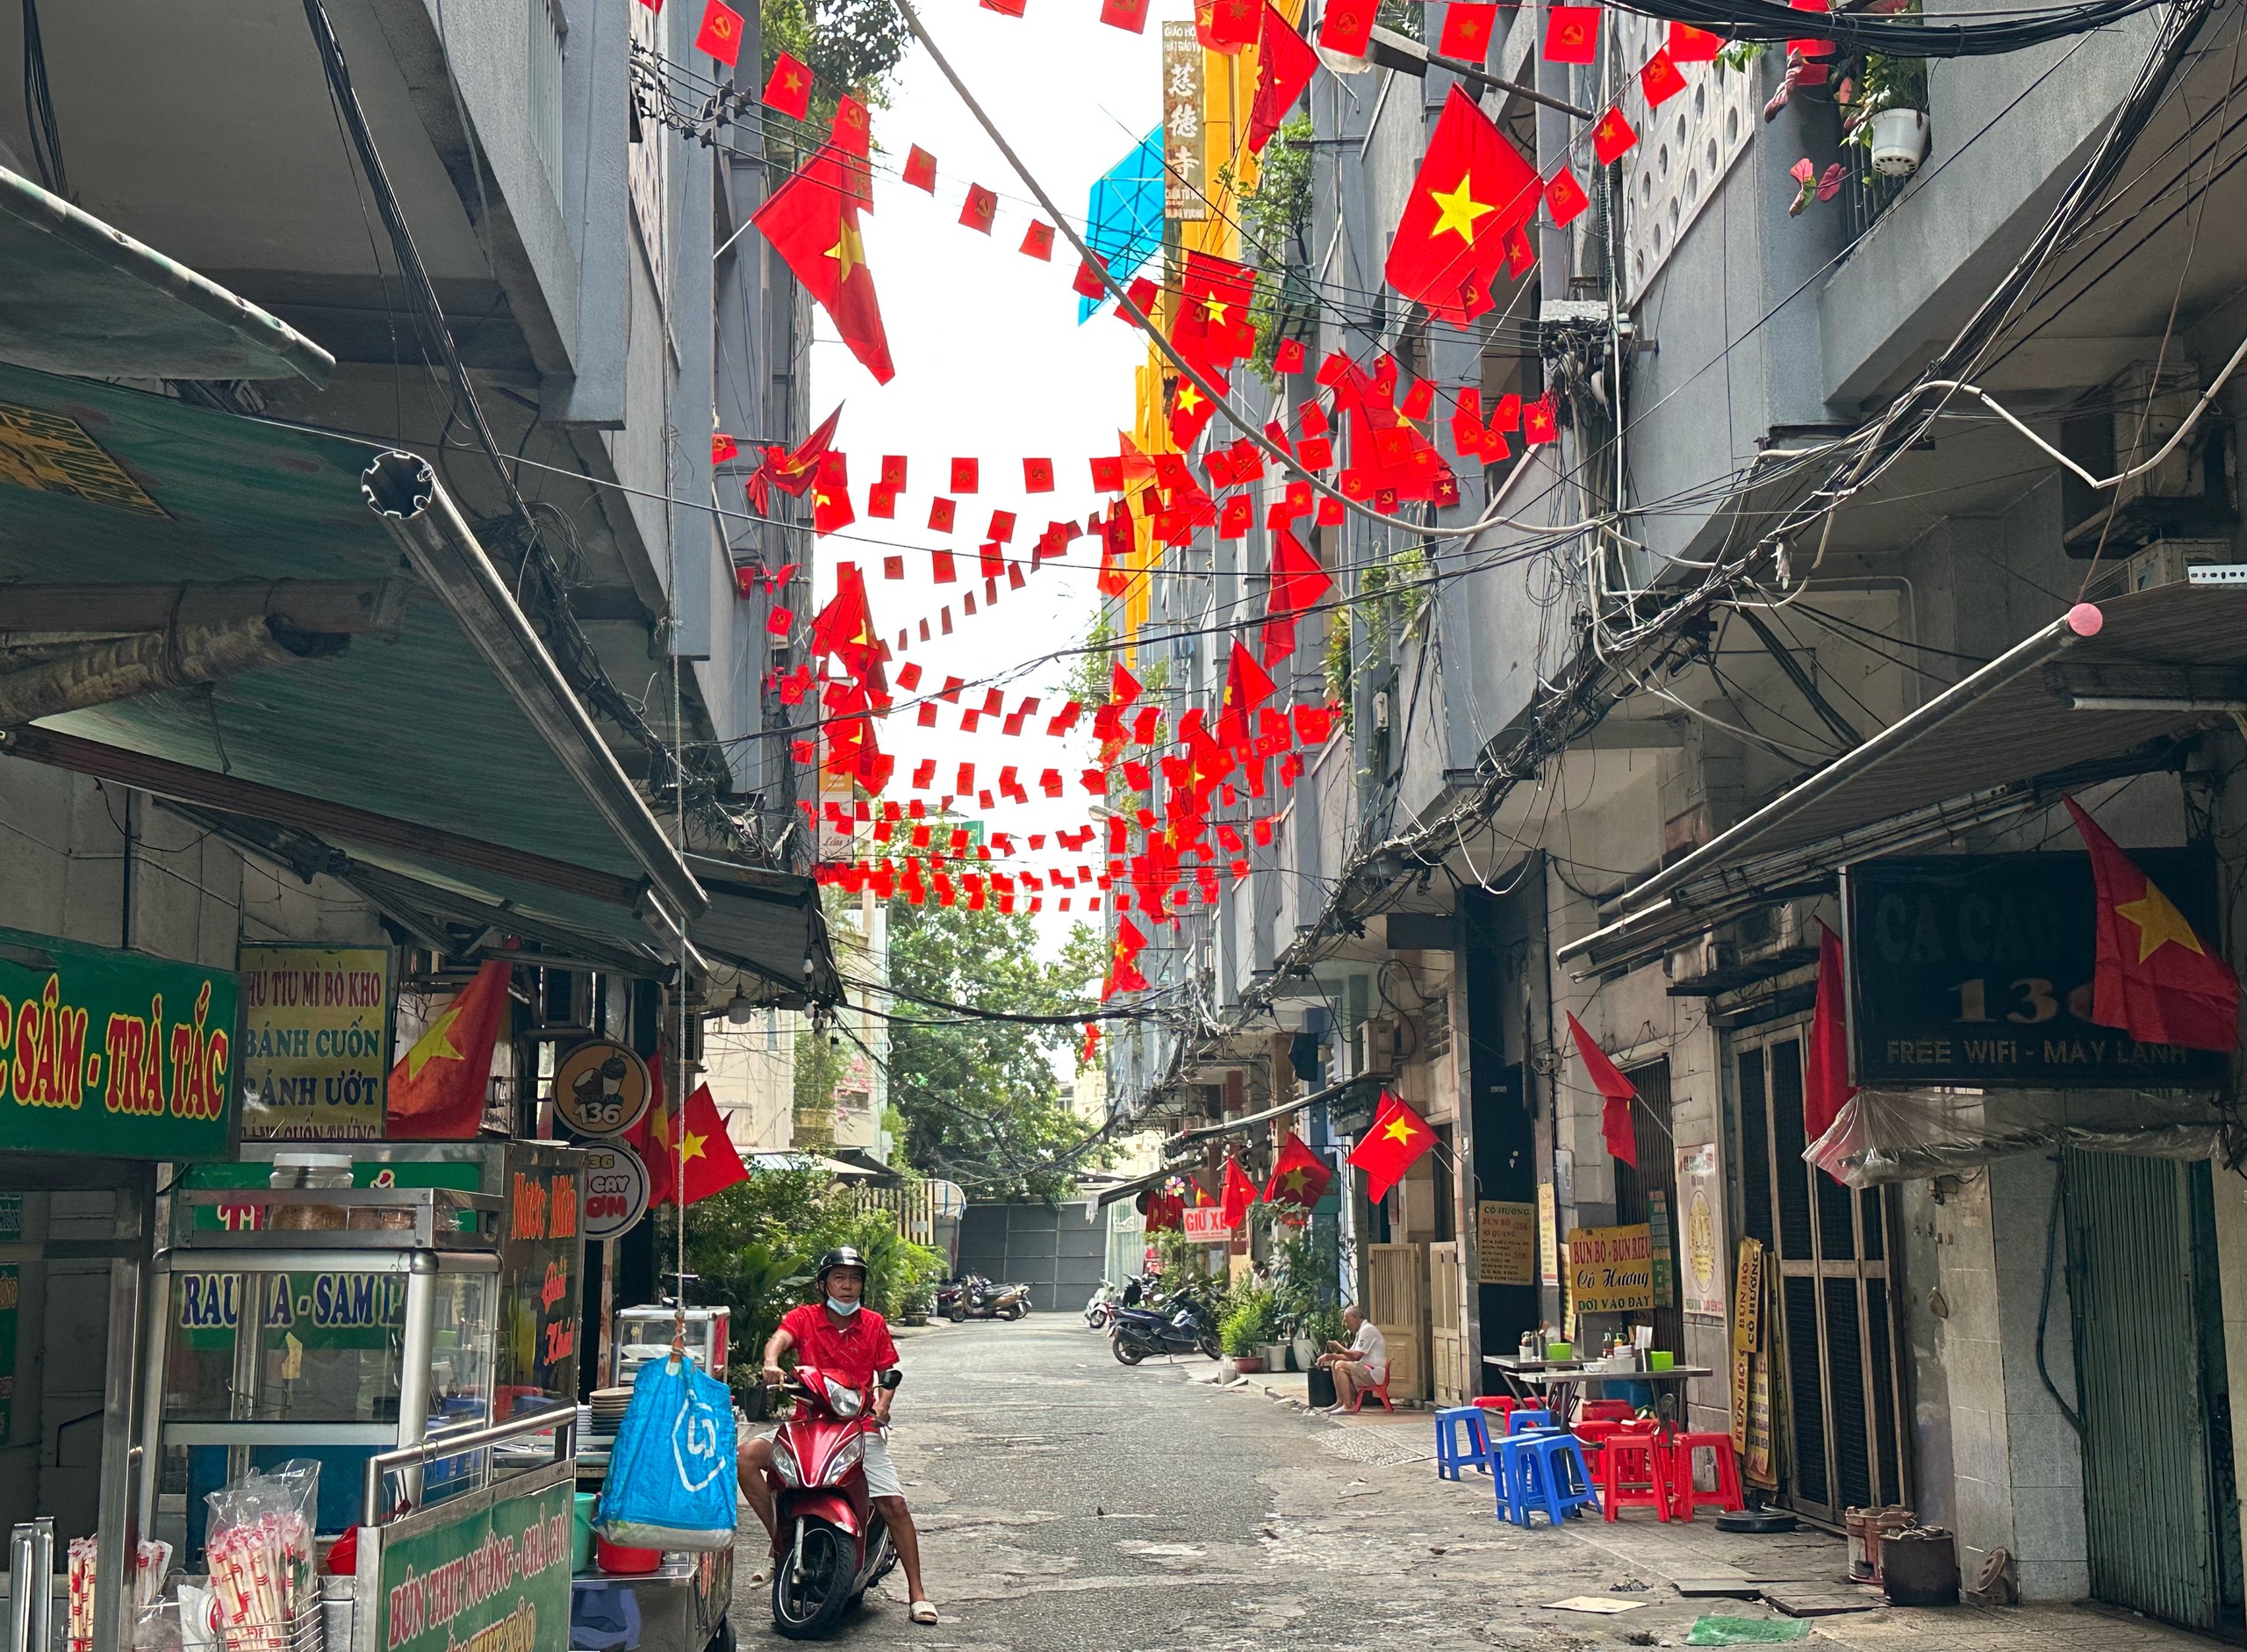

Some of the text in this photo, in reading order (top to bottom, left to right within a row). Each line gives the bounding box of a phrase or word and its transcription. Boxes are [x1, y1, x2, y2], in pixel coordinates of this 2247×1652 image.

[348, 971, 380, 1008] KHO
[170, 980, 228, 1122] TẮC
[315, 1015, 380, 1058] CUỐN
[1886, 1040, 1951, 1064] FREE
[1963, 1040, 2017, 1064] WIFI
[573, 1102, 623, 1125] 136
[587, 1154, 614, 1170] 36
[591, 1175, 630, 1194] CAY
[1573, 1234, 1592, 1265] BÚN
[1594, 1232, 1606, 1263] BÒ
[1612, 1232, 1631, 1262] BÚN
[1576, 1268, 1649, 1289] Cô Hương
[179, 1273, 239, 1329] RAU
[388, 1563, 427, 1651] BÚN
[465, 1528, 514, 1611] NƯỚNG
